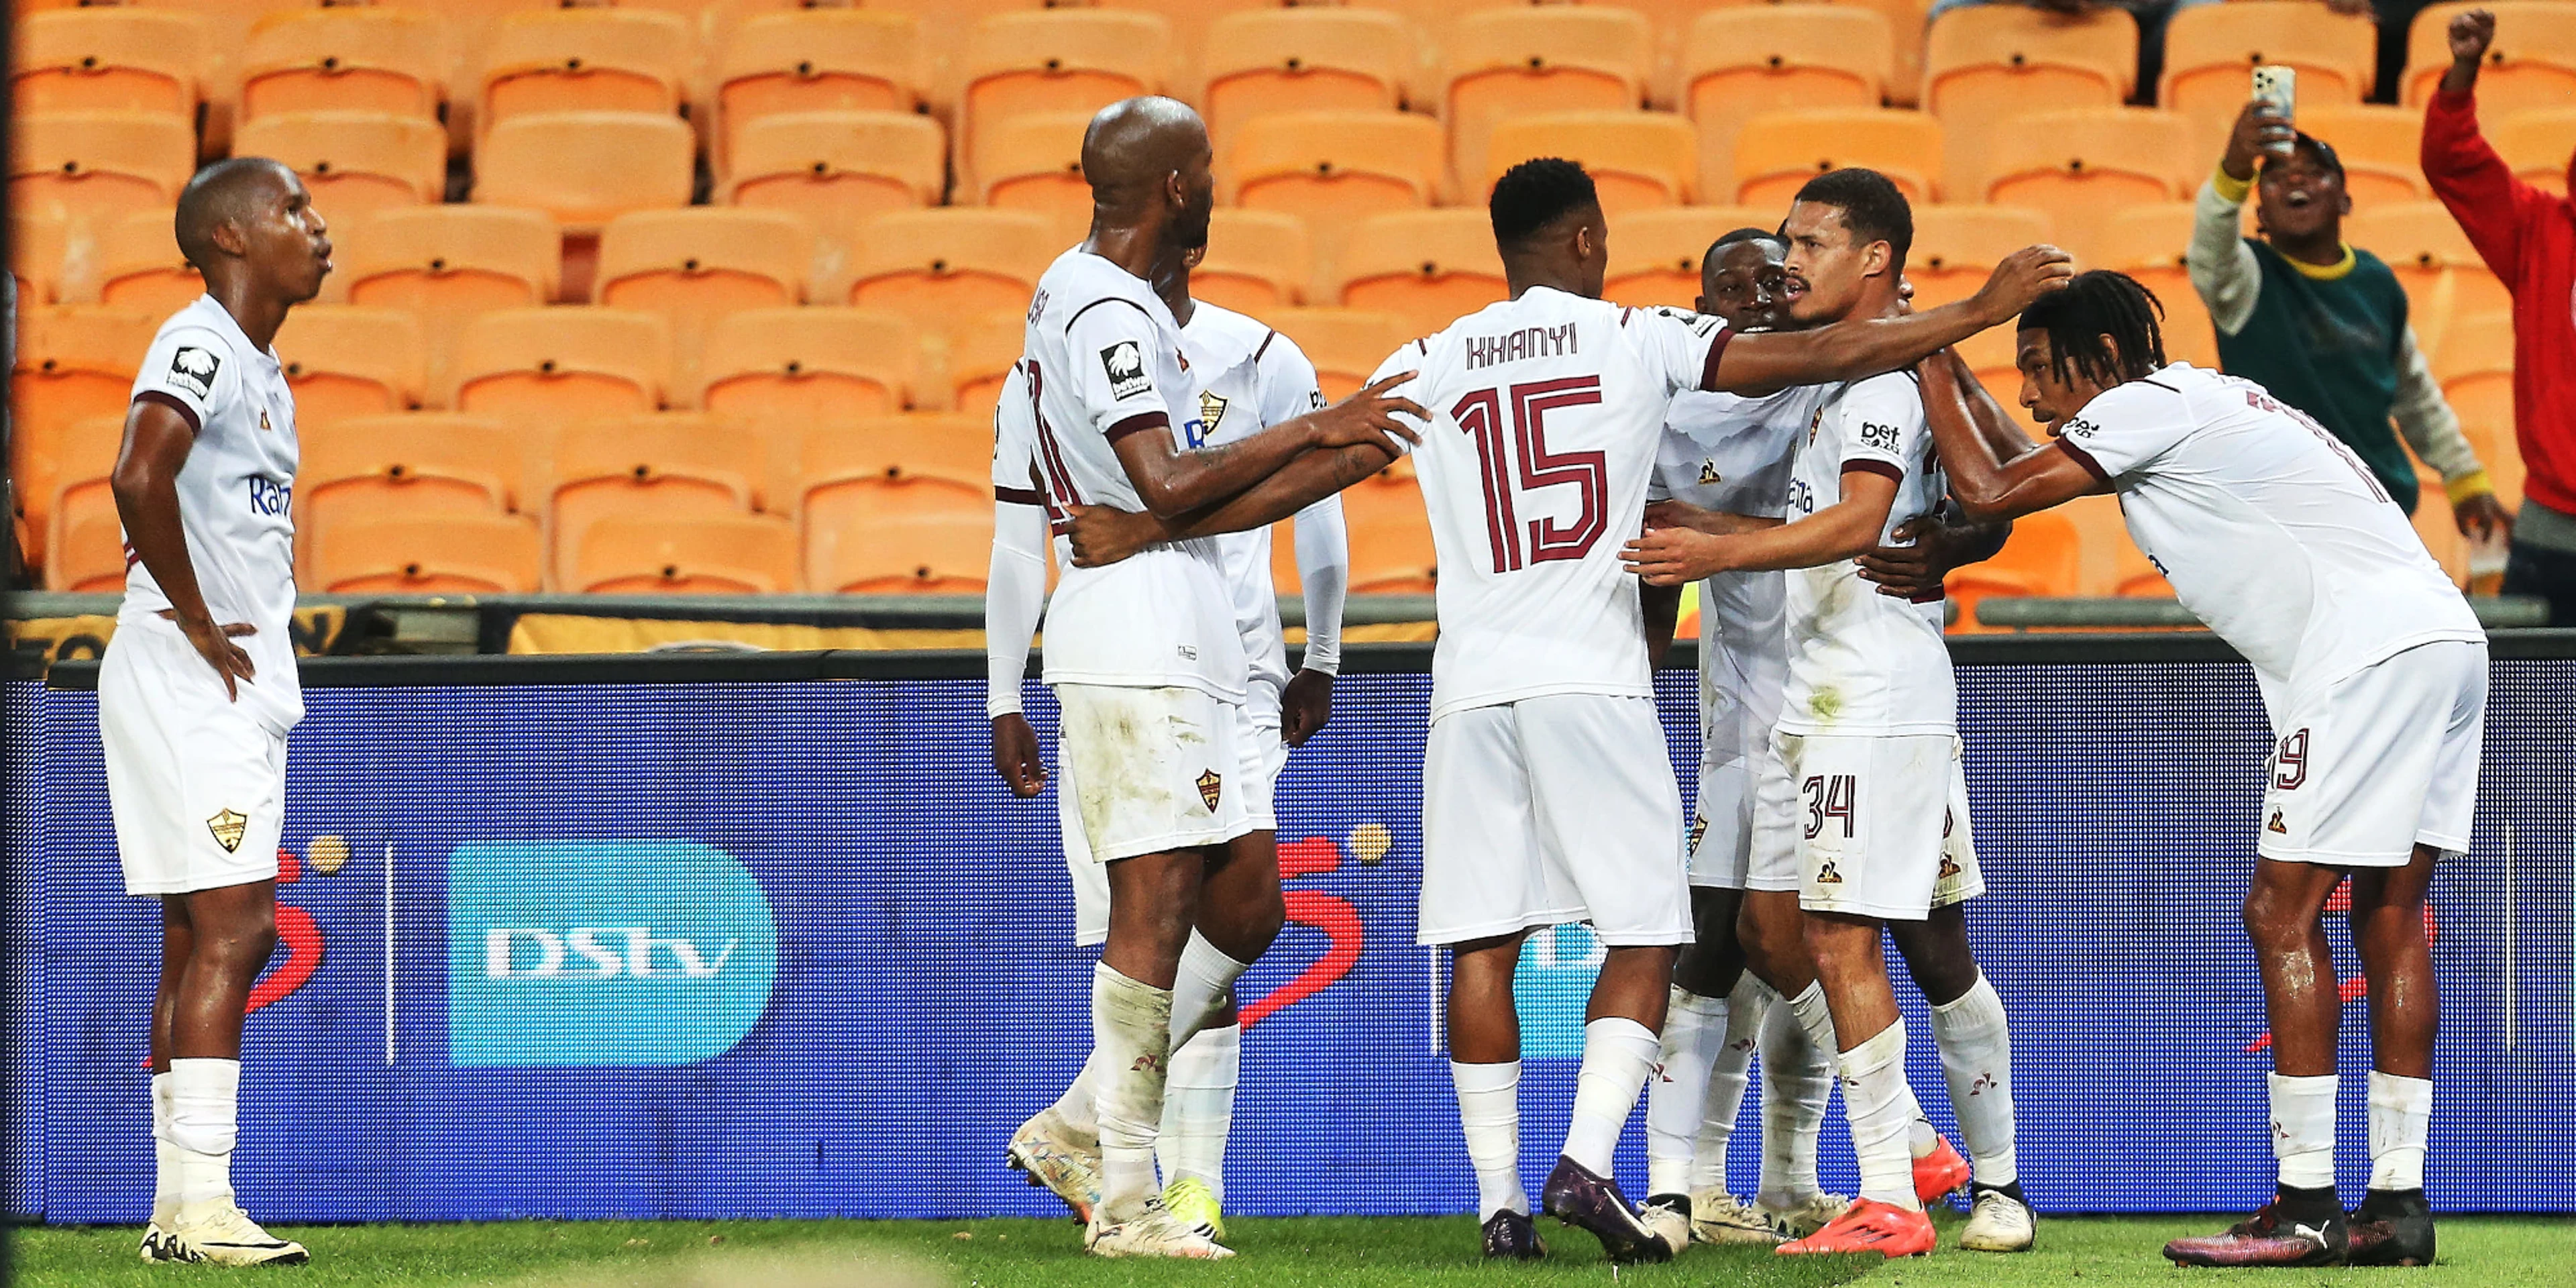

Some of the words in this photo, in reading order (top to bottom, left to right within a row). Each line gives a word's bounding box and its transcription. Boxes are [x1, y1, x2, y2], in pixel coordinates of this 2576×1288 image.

[1466, 322, 1577, 370] KHANYI
[1861, 421, 1900, 444] bet
[1450, 374, 1608, 573] 15
[1803, 775, 1856, 840] 34
[486, 926, 739, 977] DStv
